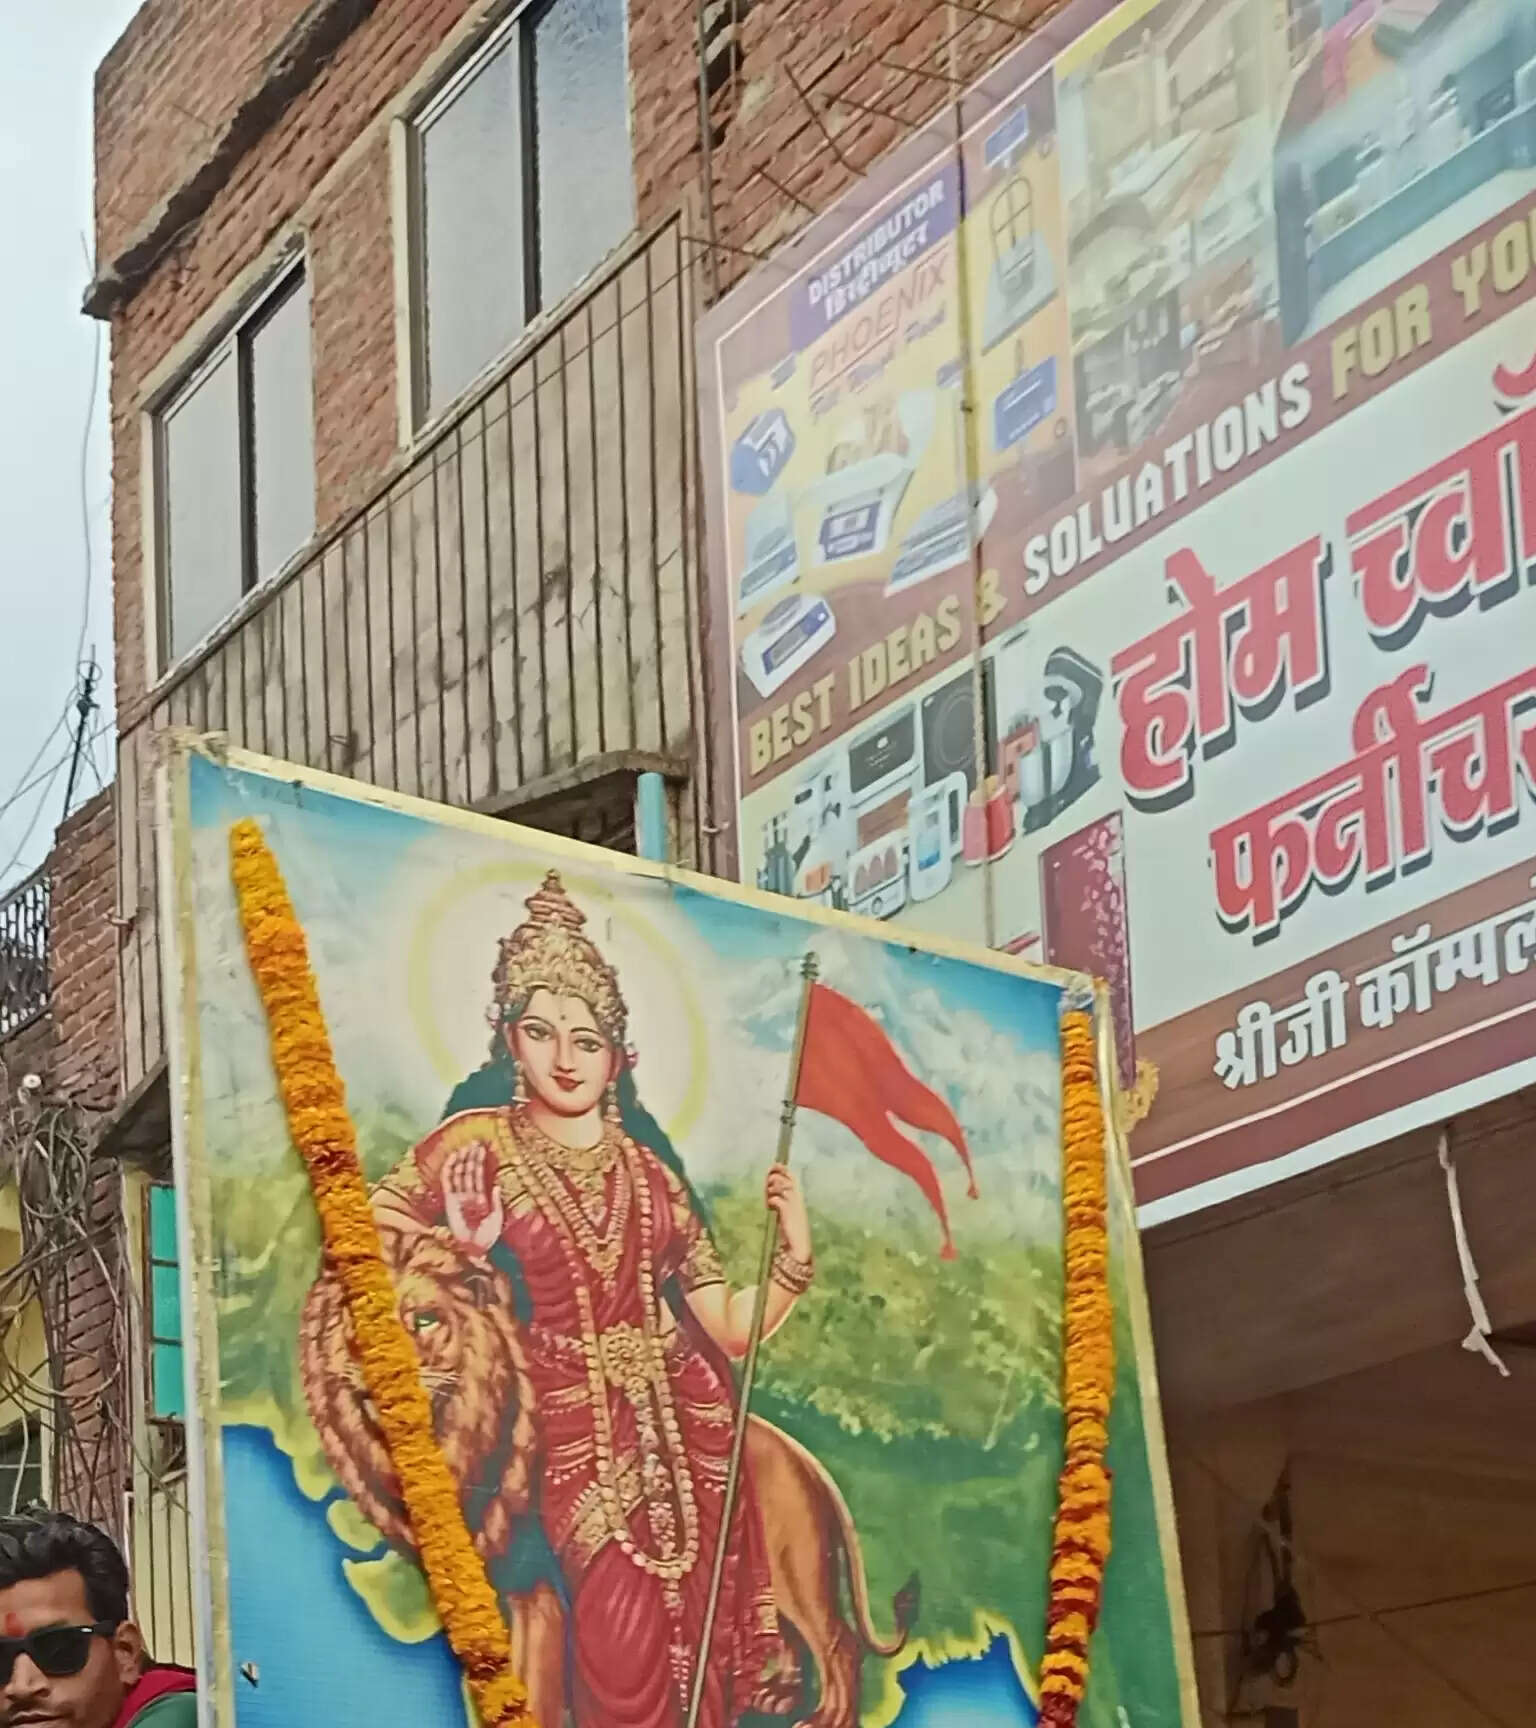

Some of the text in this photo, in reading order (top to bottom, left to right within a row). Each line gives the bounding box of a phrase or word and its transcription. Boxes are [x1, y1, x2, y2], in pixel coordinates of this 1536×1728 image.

[808, 180, 945, 306] DISTRIBUTOR
[811, 250, 948, 377] PHOENIX
[748, 680, 837, 778] BEST
[848, 594, 963, 713] IDEAS
[1023, 360, 1312, 597] SOLUATIONS
[1330, 279, 1434, 402] FOR
[1110, 533, 1328, 802] होम
[1213, 969, 1350, 1090] श्रीजी
